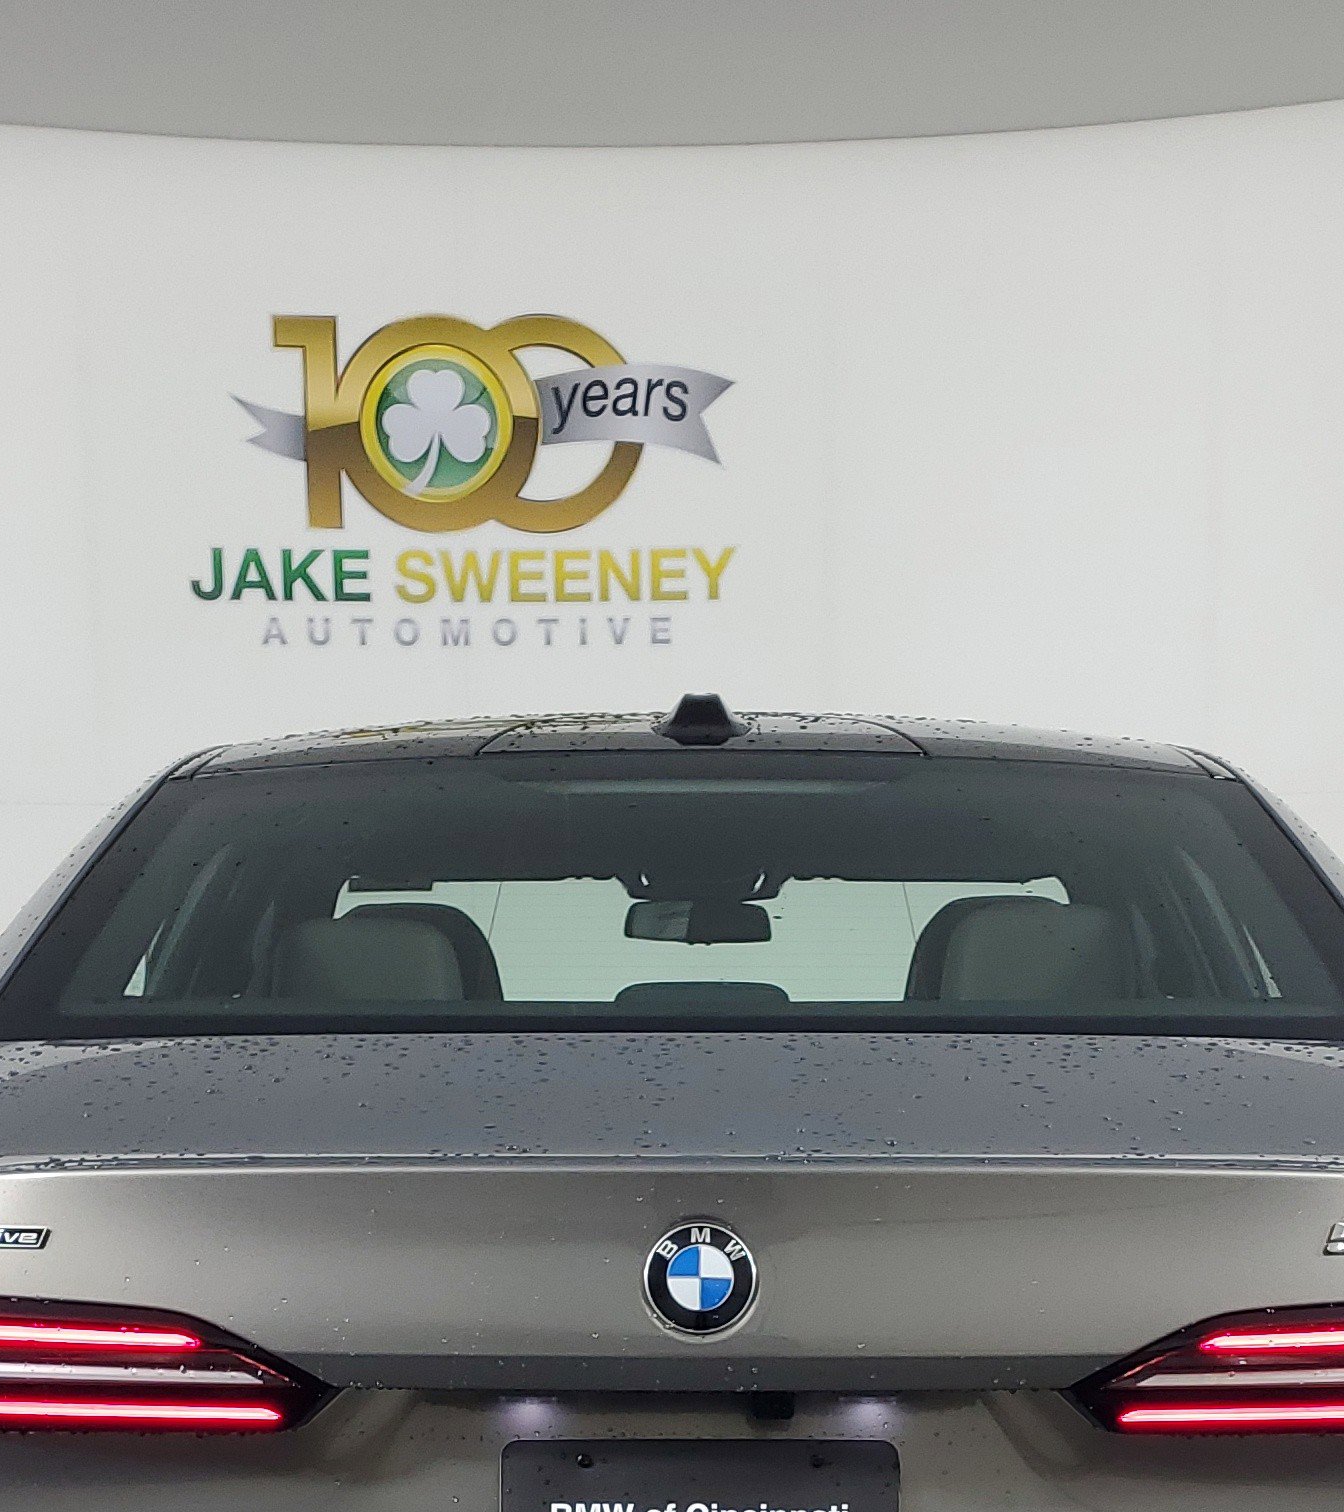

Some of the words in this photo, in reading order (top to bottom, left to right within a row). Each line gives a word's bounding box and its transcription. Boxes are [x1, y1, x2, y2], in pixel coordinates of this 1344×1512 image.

[271, 313, 644, 533] 100
[550, 376, 690, 435] years
[191, 547, 371, 602] JAKE
[395, 546, 737, 603] SWEENEY
[261, 616, 673, 646] AUTOMOTIVE
[656, 1227, 746, 1261] BMW
